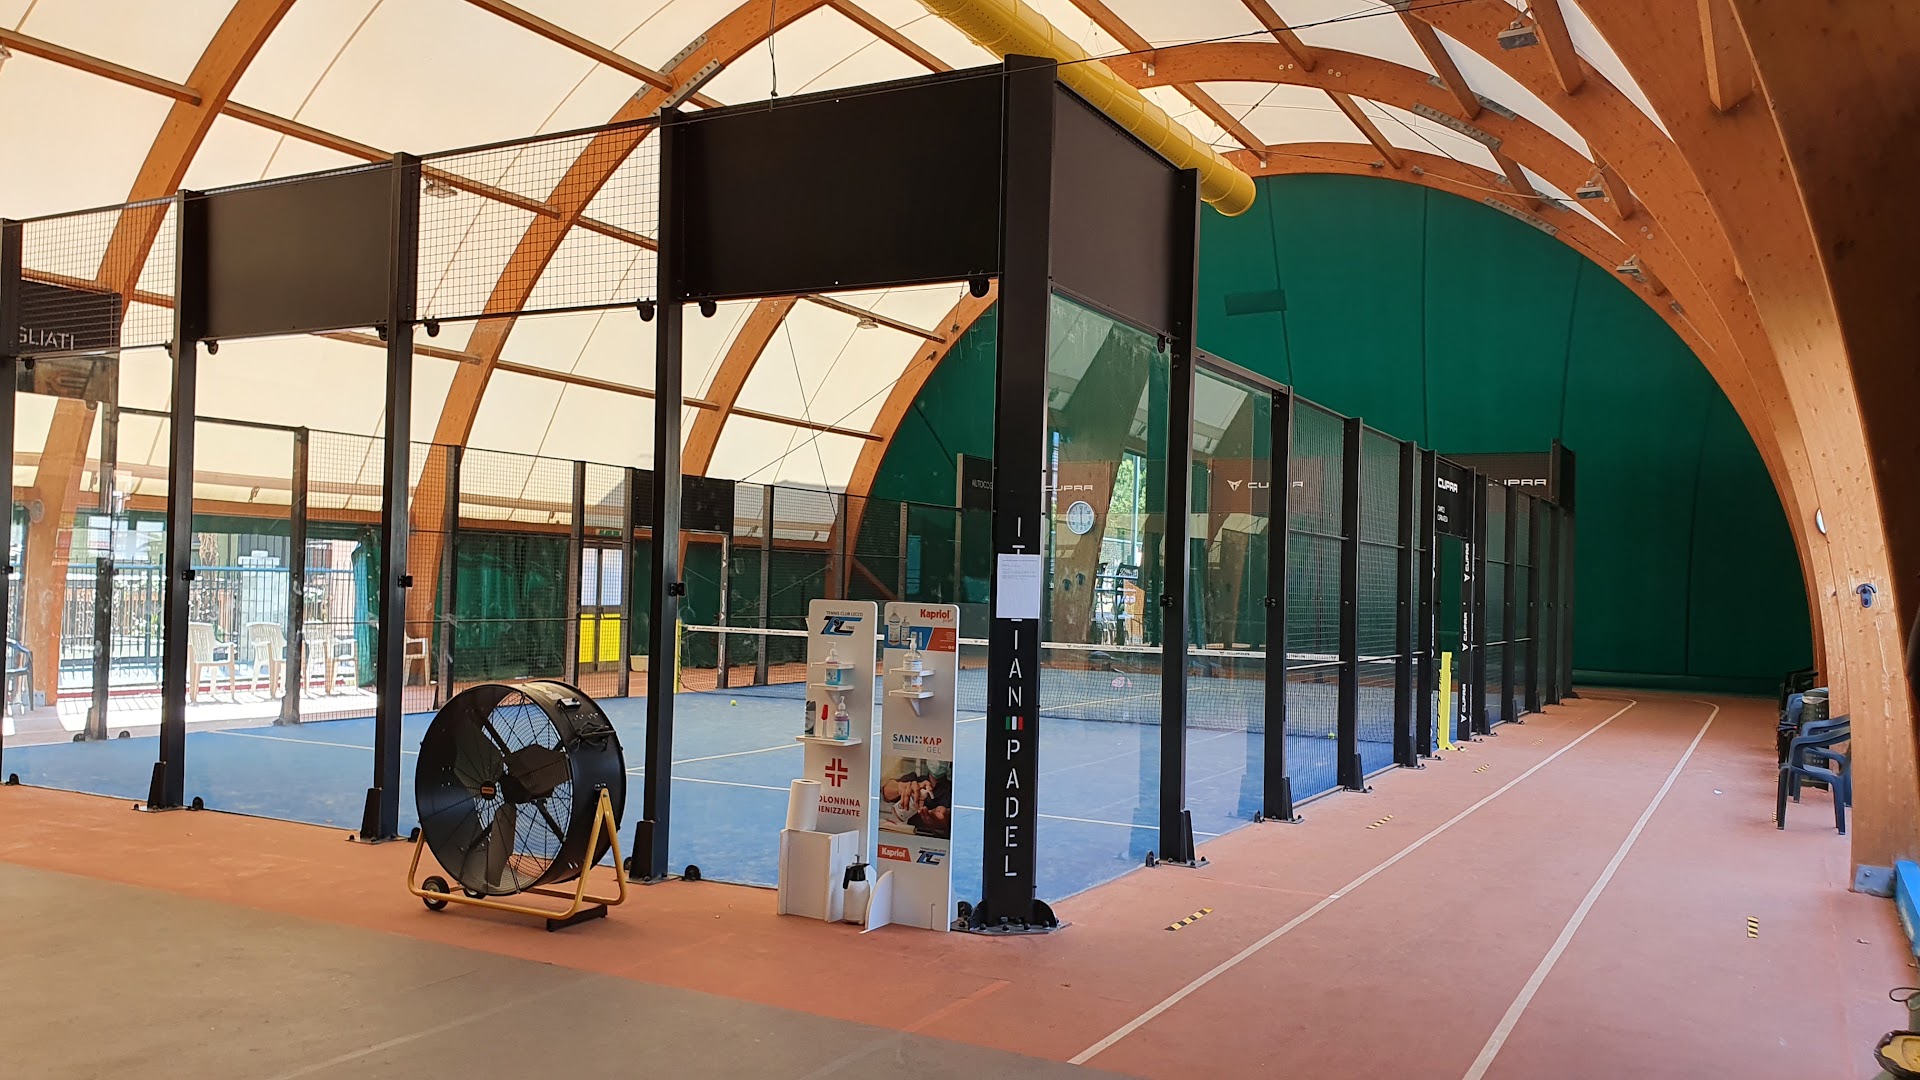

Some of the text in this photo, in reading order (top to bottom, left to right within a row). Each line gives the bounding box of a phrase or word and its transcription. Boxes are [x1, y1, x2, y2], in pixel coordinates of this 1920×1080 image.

[1247, 481, 1304, 489] CUA
[1437, 477, 1458, 493] CUPRA
[920, 608, 950, 620] Kapriol
[926, 746, 942, 755] GEL
[819, 795, 861, 808] OLONNINA
[818, 805, 861, 817] IENIZZANTE
[1004, 738, 1022, 878] PADEL
[881, 846, 907, 858] Kapriol
